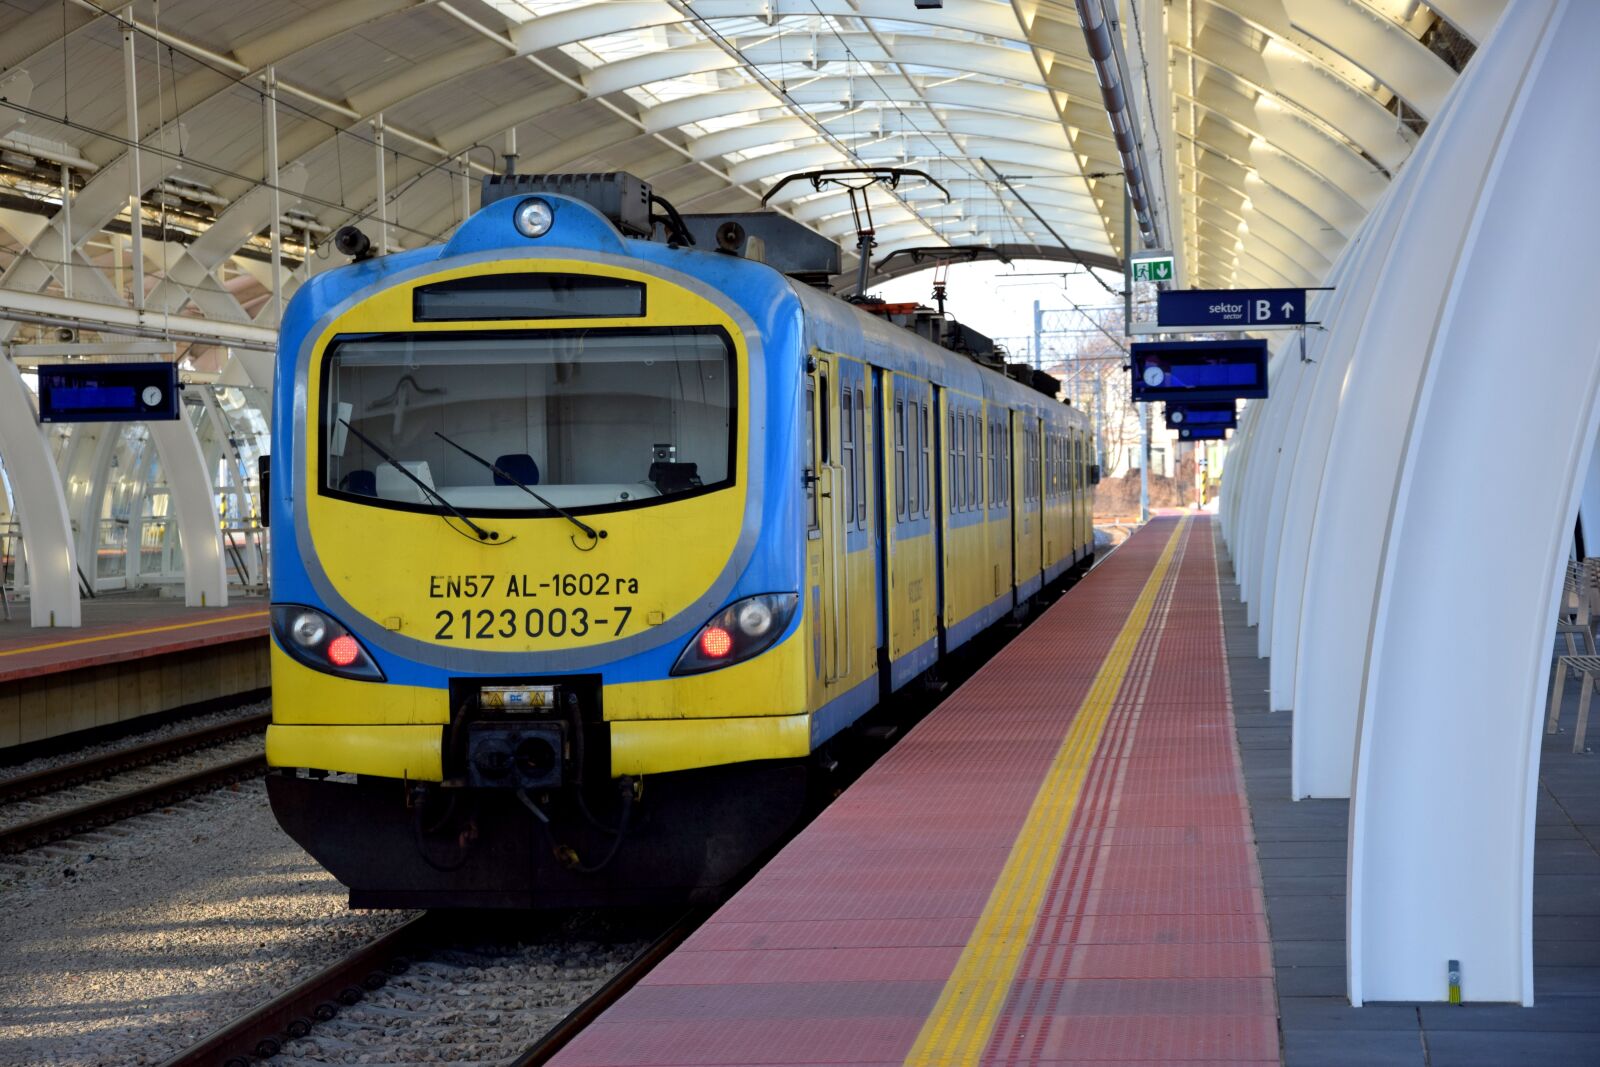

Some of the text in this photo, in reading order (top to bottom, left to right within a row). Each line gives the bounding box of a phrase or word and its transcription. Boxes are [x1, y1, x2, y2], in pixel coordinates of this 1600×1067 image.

[1209, 300, 1271, 320] sektor B
[430, 575, 495, 598] EN57
